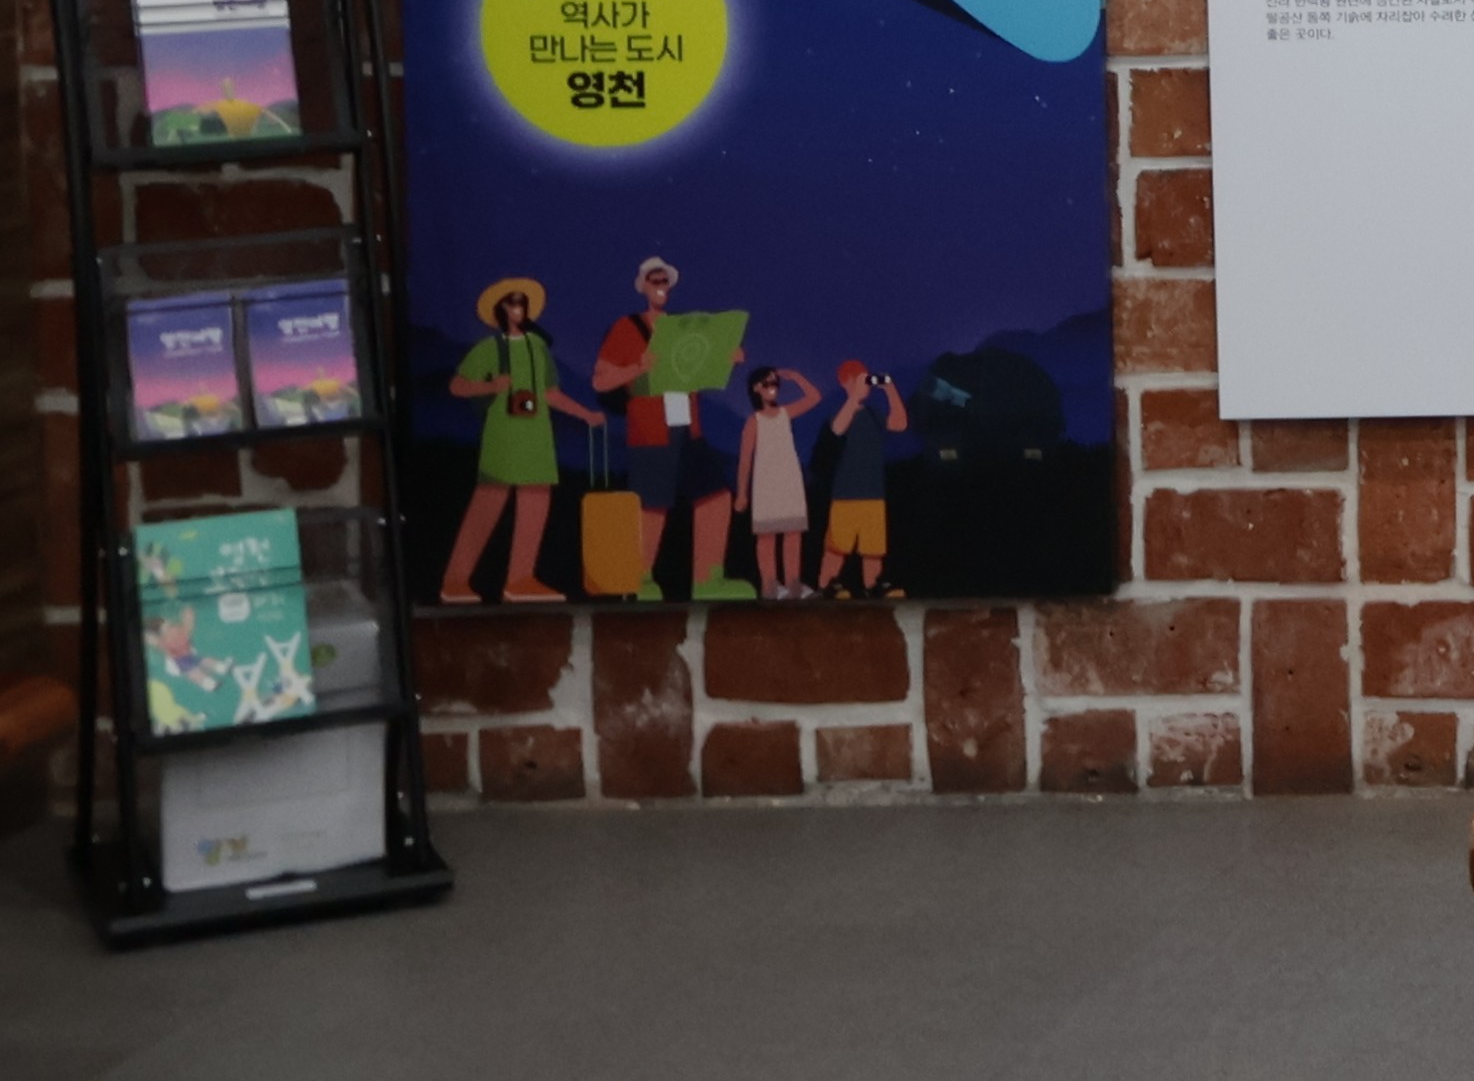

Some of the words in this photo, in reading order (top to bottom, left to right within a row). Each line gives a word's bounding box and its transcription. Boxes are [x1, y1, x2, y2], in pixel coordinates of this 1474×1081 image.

[561, 1, 651, 29] 역사가
[529, 34, 618, 63] 만나는
[626, 34, 683, 62] 도시
[567, 70, 646, 109] 영천
